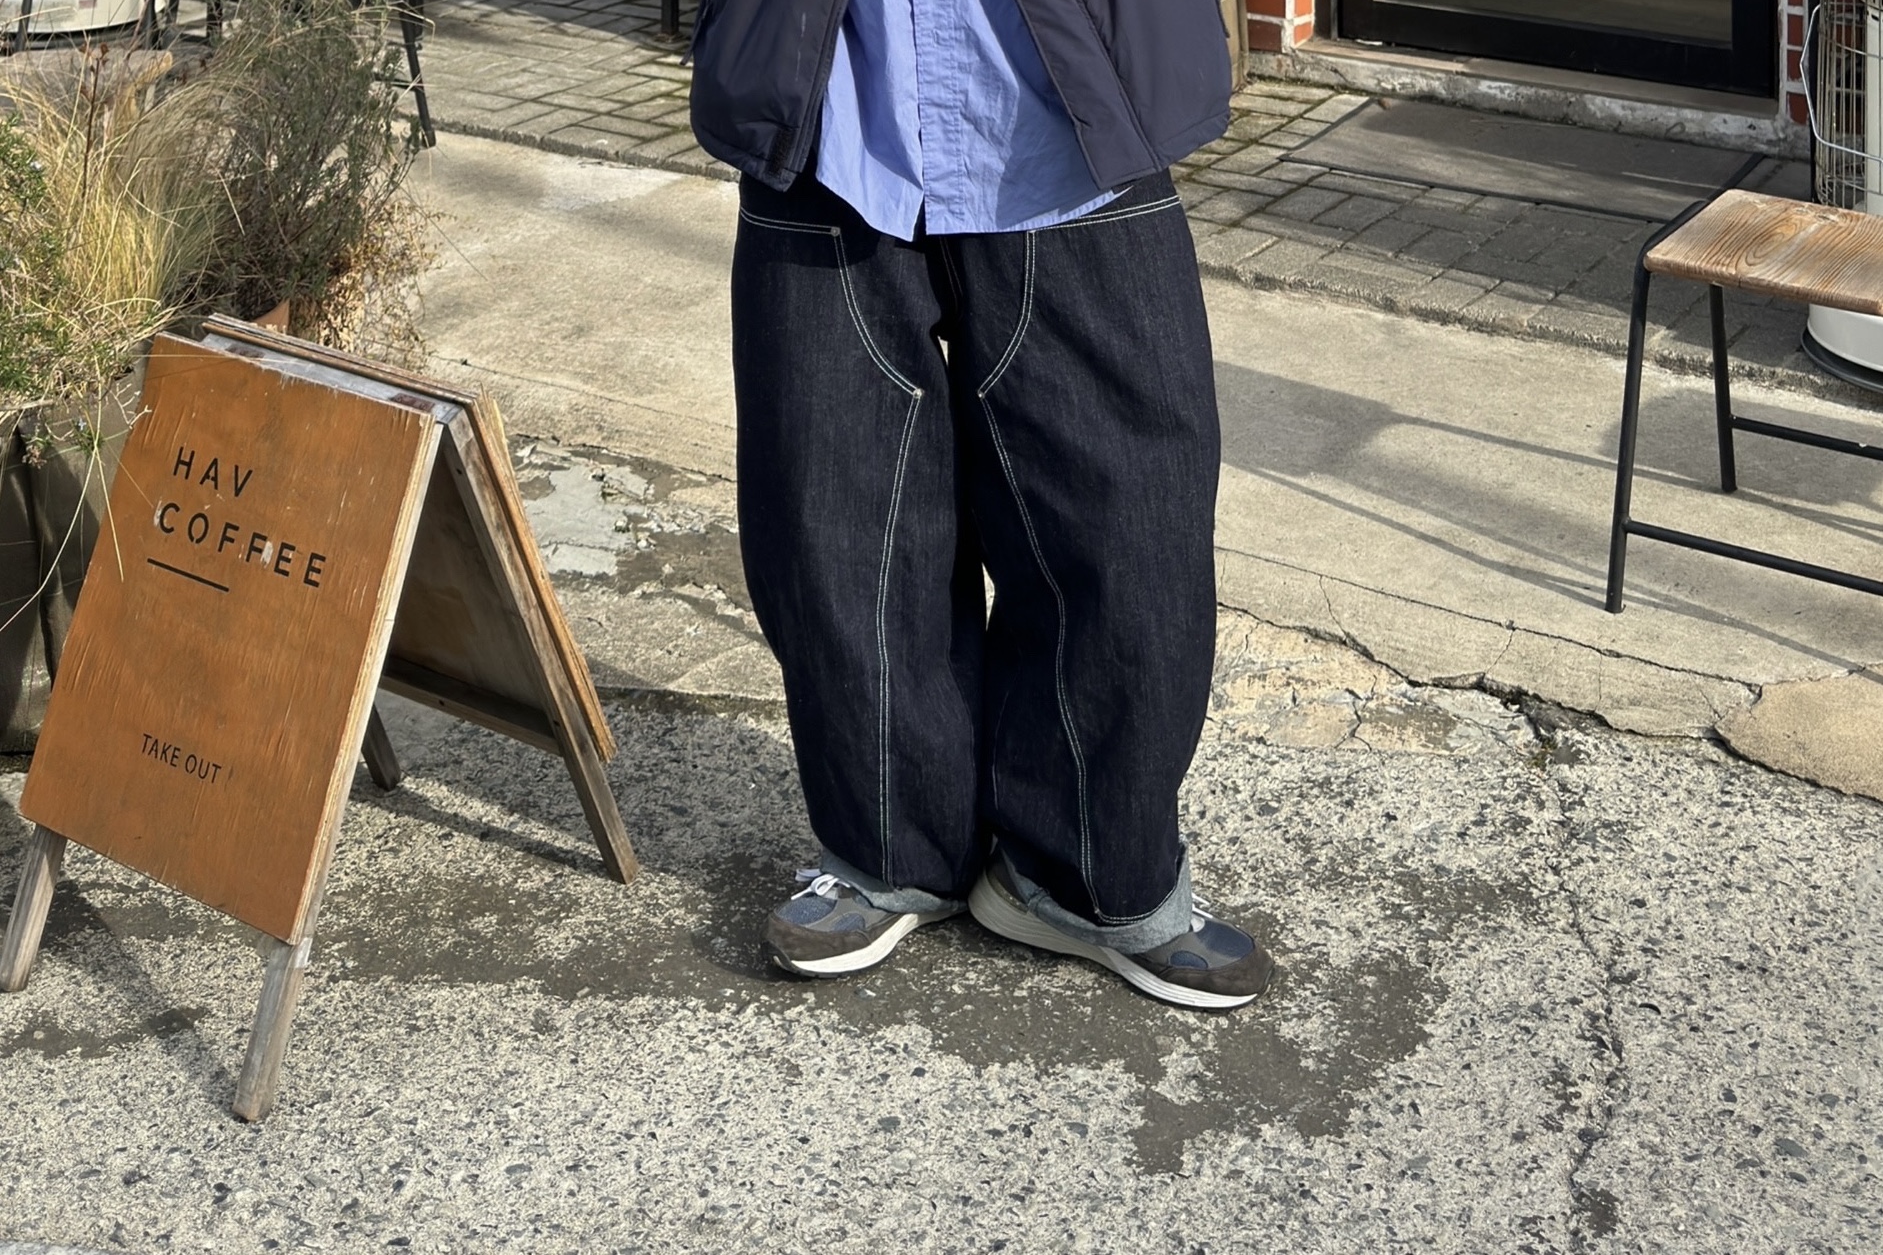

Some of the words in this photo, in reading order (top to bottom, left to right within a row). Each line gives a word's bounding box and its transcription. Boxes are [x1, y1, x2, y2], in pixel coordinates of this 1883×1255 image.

[173, 446, 253, 497] HAV
[159, 502, 326, 588] COFFEE
[142, 733, 181, 768] TAKE
[185, 754, 222, 783] OUT
